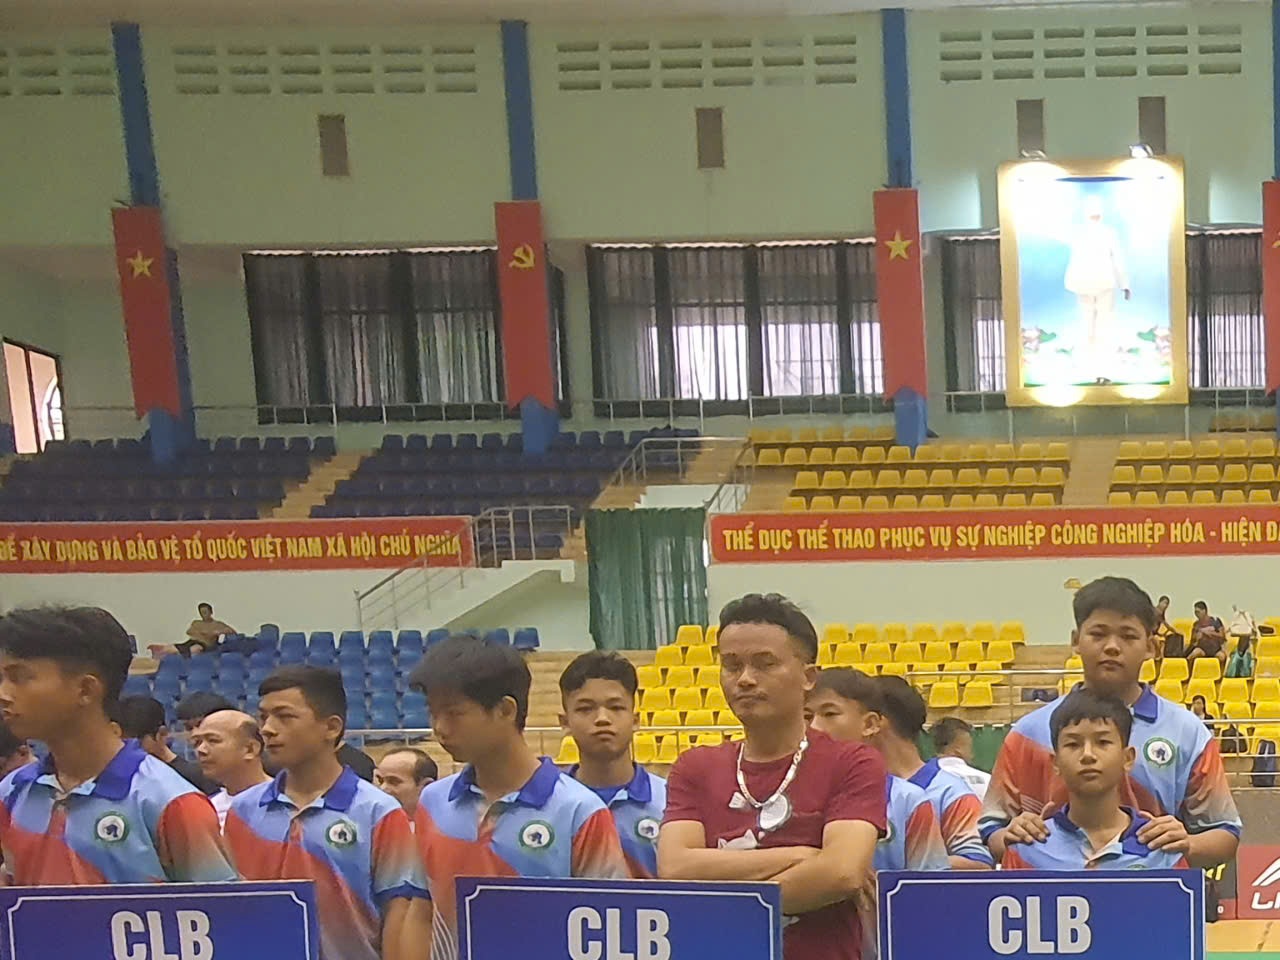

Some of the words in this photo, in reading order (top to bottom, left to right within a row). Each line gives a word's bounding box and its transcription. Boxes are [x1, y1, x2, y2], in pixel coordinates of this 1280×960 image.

[250, 533, 282, 563] VIỆT
[286, 537, 323, 558] NAM
[758, 529, 793, 555] DỤC
[832, 527, 874, 550] THAO
[879, 526, 925, 552] PHỤC
[929, 525, 952, 552] VỤ
[956, 523, 982, 551] SỰ
[984, 520, 1046, 550] NGHIỆP
[1050, 519, 1098, 545] CÔNG
[1102, 518, 1165, 548] NGHIỆP
[1169, 517, 1206, 544] HÓA
[1221, 516, 1261, 546] HIỆN
[988, 895, 1092, 954] CLB
